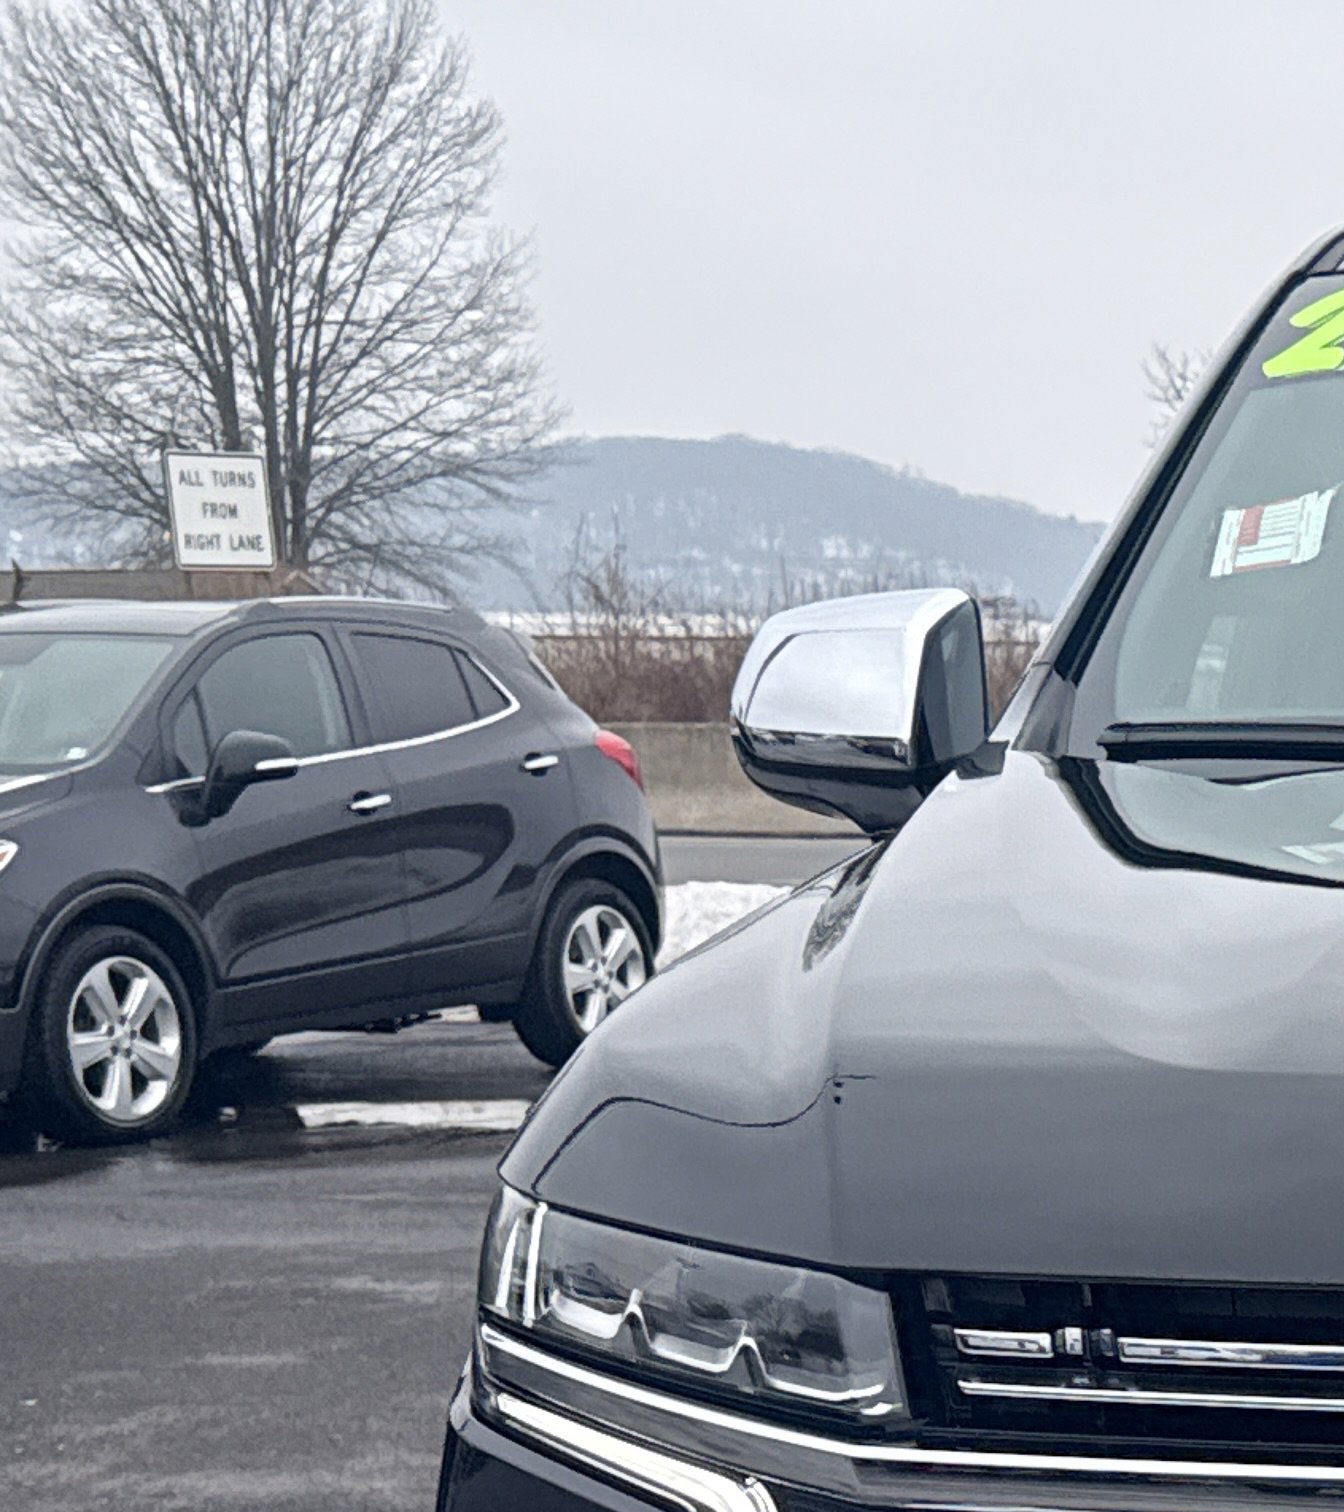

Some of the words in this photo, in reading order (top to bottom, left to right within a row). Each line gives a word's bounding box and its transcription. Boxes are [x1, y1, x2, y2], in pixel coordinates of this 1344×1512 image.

[179, 469, 204, 487] ALL
[212, 470, 256, 488] TURNS
[202, 502, 238, 519] FROM
[184, 533, 221, 551] RIGHT
[229, 534, 264, 552] LANE
